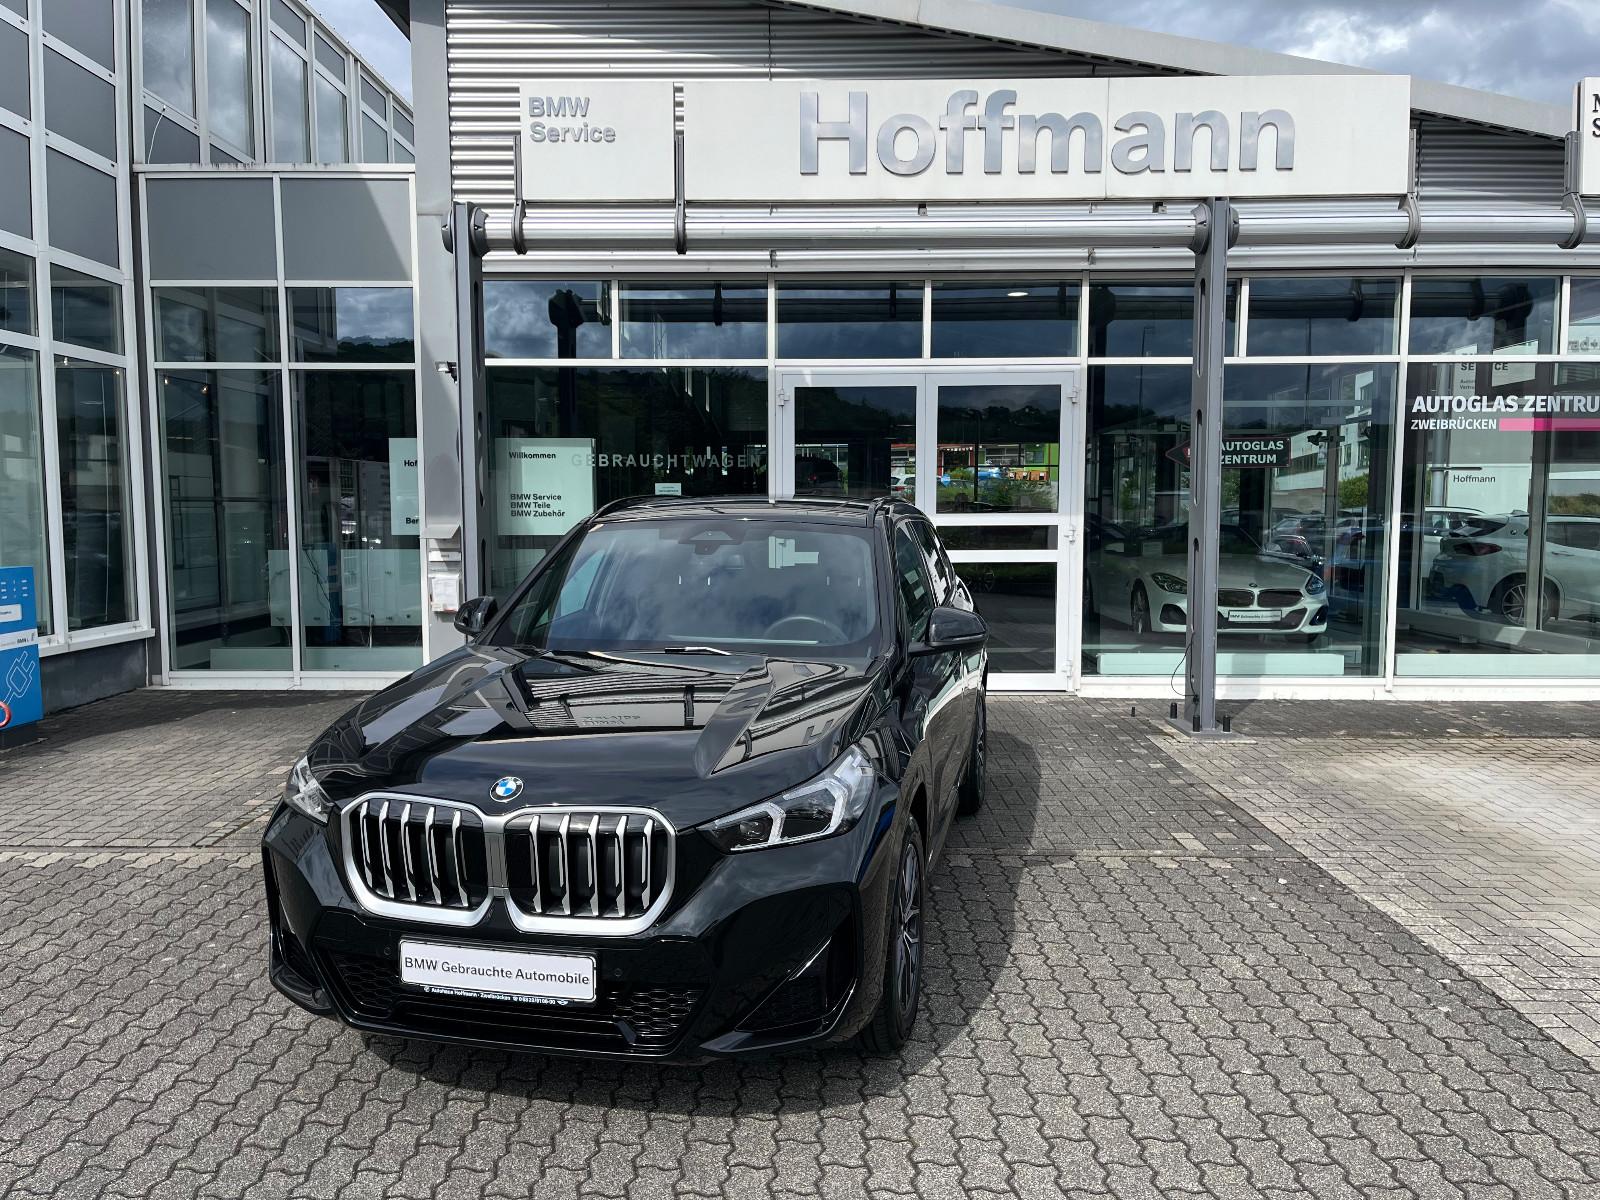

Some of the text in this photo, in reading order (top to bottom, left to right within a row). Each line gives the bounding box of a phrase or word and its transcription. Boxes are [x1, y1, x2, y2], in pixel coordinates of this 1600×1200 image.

[528, 97, 590, 117] BMW
[529, 121, 616, 143] Service
[799, 89, 1296, 176] Hoffmann
[1411, 395, 1600, 413] AUTOGLAS ZENTRU
[1410, 416, 1497, 430] ZWEIBRÜCKEN
[508, 451, 557, 459] Willkommen
[571, 454, 762, 468] GEBRAUCHTWAGEN
[1453, 474, 1496, 483] Hoffmann
[533, 501, 551, 509] Teile
[533, 509, 566, 517] Zubehör
[404, 957, 590, 985] BMW Gebrauchte Automobile
